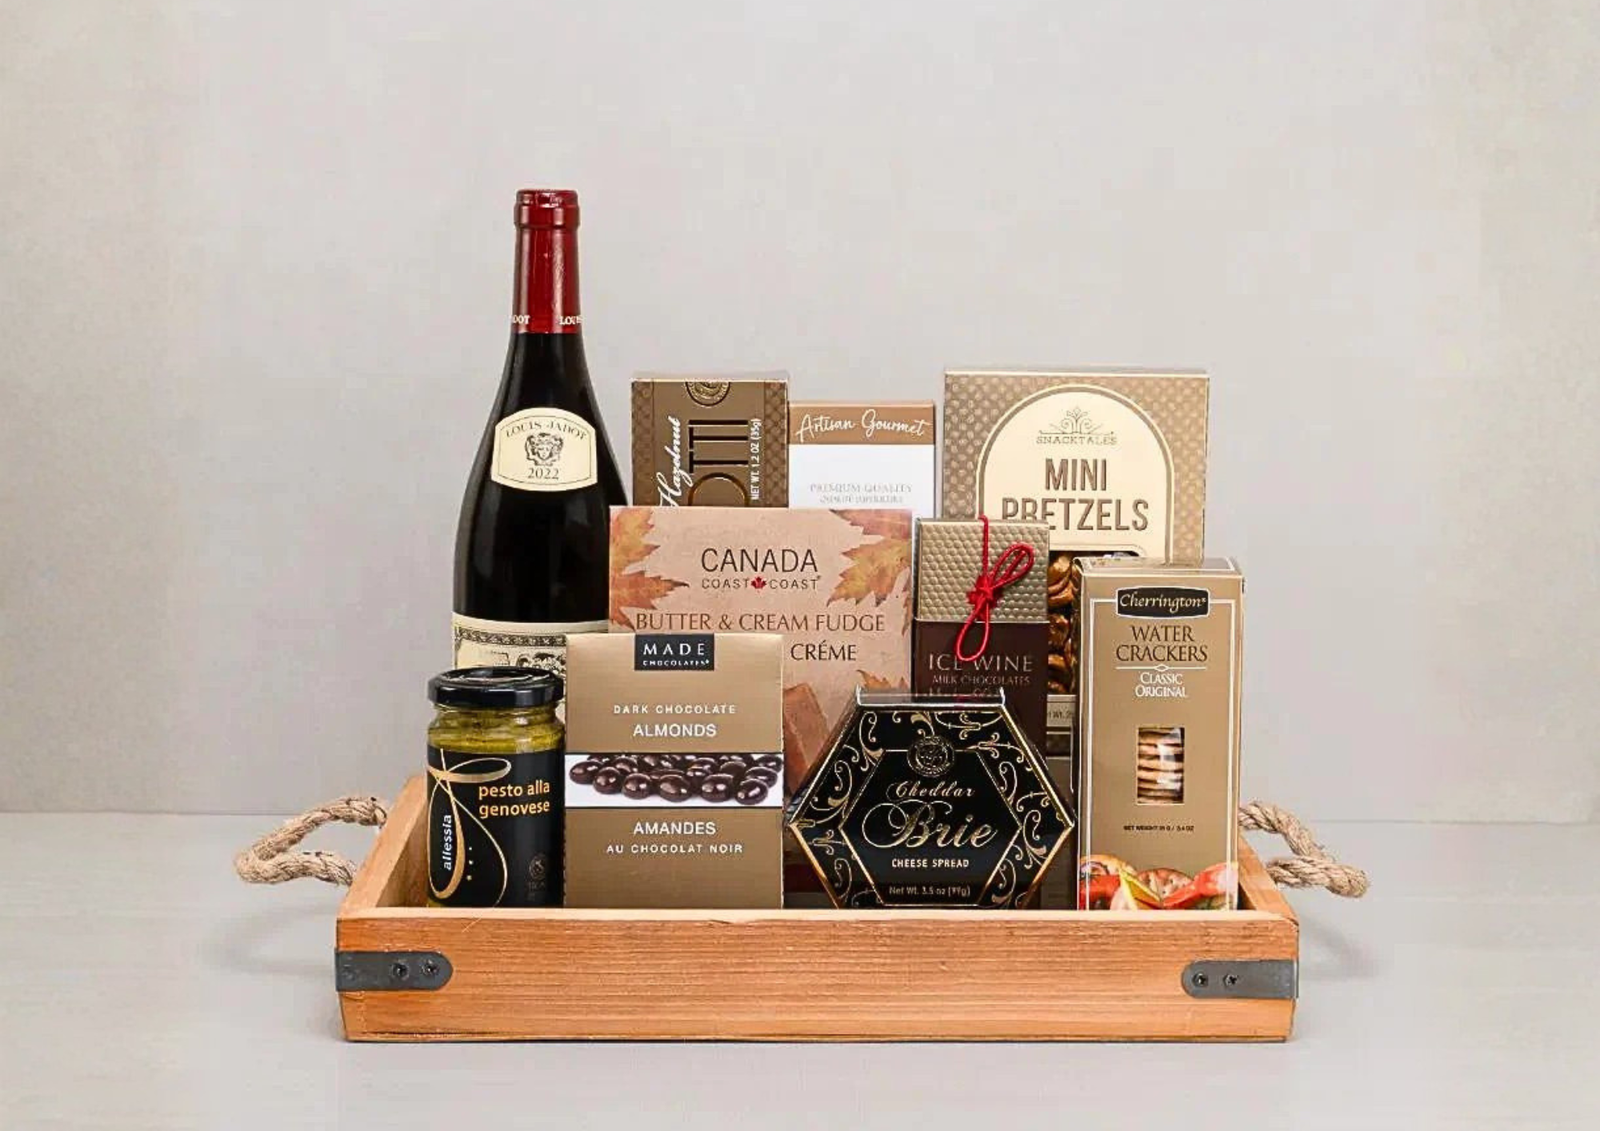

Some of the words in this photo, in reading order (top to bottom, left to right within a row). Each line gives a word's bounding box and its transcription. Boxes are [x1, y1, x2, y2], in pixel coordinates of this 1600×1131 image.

[506, 421, 542, 438] LOUIS
[796, 413, 855, 443] Artisan
[861, 408, 931, 438] Gourmet
[750, 442, 760, 454] OZ
[1036, 435, 1118, 446] SNACKTALES
[656, 415, 694, 506] Hazelnut
[528, 467, 560, 480] 2022
[1045, 458, 1107, 491] MINI
[750, 485, 760, 500] NET
[810, 482, 861, 493] PREMIUM
[864, 482, 913, 493] QUALITY
[1002, 497, 1149, 532] PRETZELS
[701, 547, 818, 573] CANADA
[701, 578, 750, 590] COAST
[636, 613, 712, 631] BUTTER
[718, 613, 732, 631] &
[738, 614, 809, 632] CREAM
[815, 614, 885, 632] FUDGE
[1131, 625, 1195, 642] WATER
[643, 643, 705, 656] MADE
[790, 639, 857, 662] CRÉME
[1116, 645, 1208, 663] CRACKERS
[929, 654, 963, 671] ICE
[974, 654, 1033, 672] WINE
[932, 675, 958, 685] MILK
[961, 675, 1031, 685] CHOCOLATES
[613, 704, 649, 715] DARK
[655, 704, 737, 715] CHOCOLATE
[633, 723, 717, 738] ALMONDS
[478, 784, 524, 800] pesto
[527, 779, 550, 796] alla
[888, 780, 976, 799] Cheddar
[479, 801, 550, 819] genovese
[633, 821, 717, 836] AMANDES
[862, 799, 999, 849] Brie
[442, 814, 453, 871] allessia
[607, 844, 624, 854] AU
[630, 844, 703, 854] CHOCOLAT
[709, 844, 743, 854] NOIR
[891, 858, 928, 868] CHEESE
[932, 858, 970, 868] SPREAD
[889, 885, 904, 896] Net
[906, 885, 919, 896] Wt.
[921, 885, 934, 896] 3.5
[936, 887, 946, 896] oz
